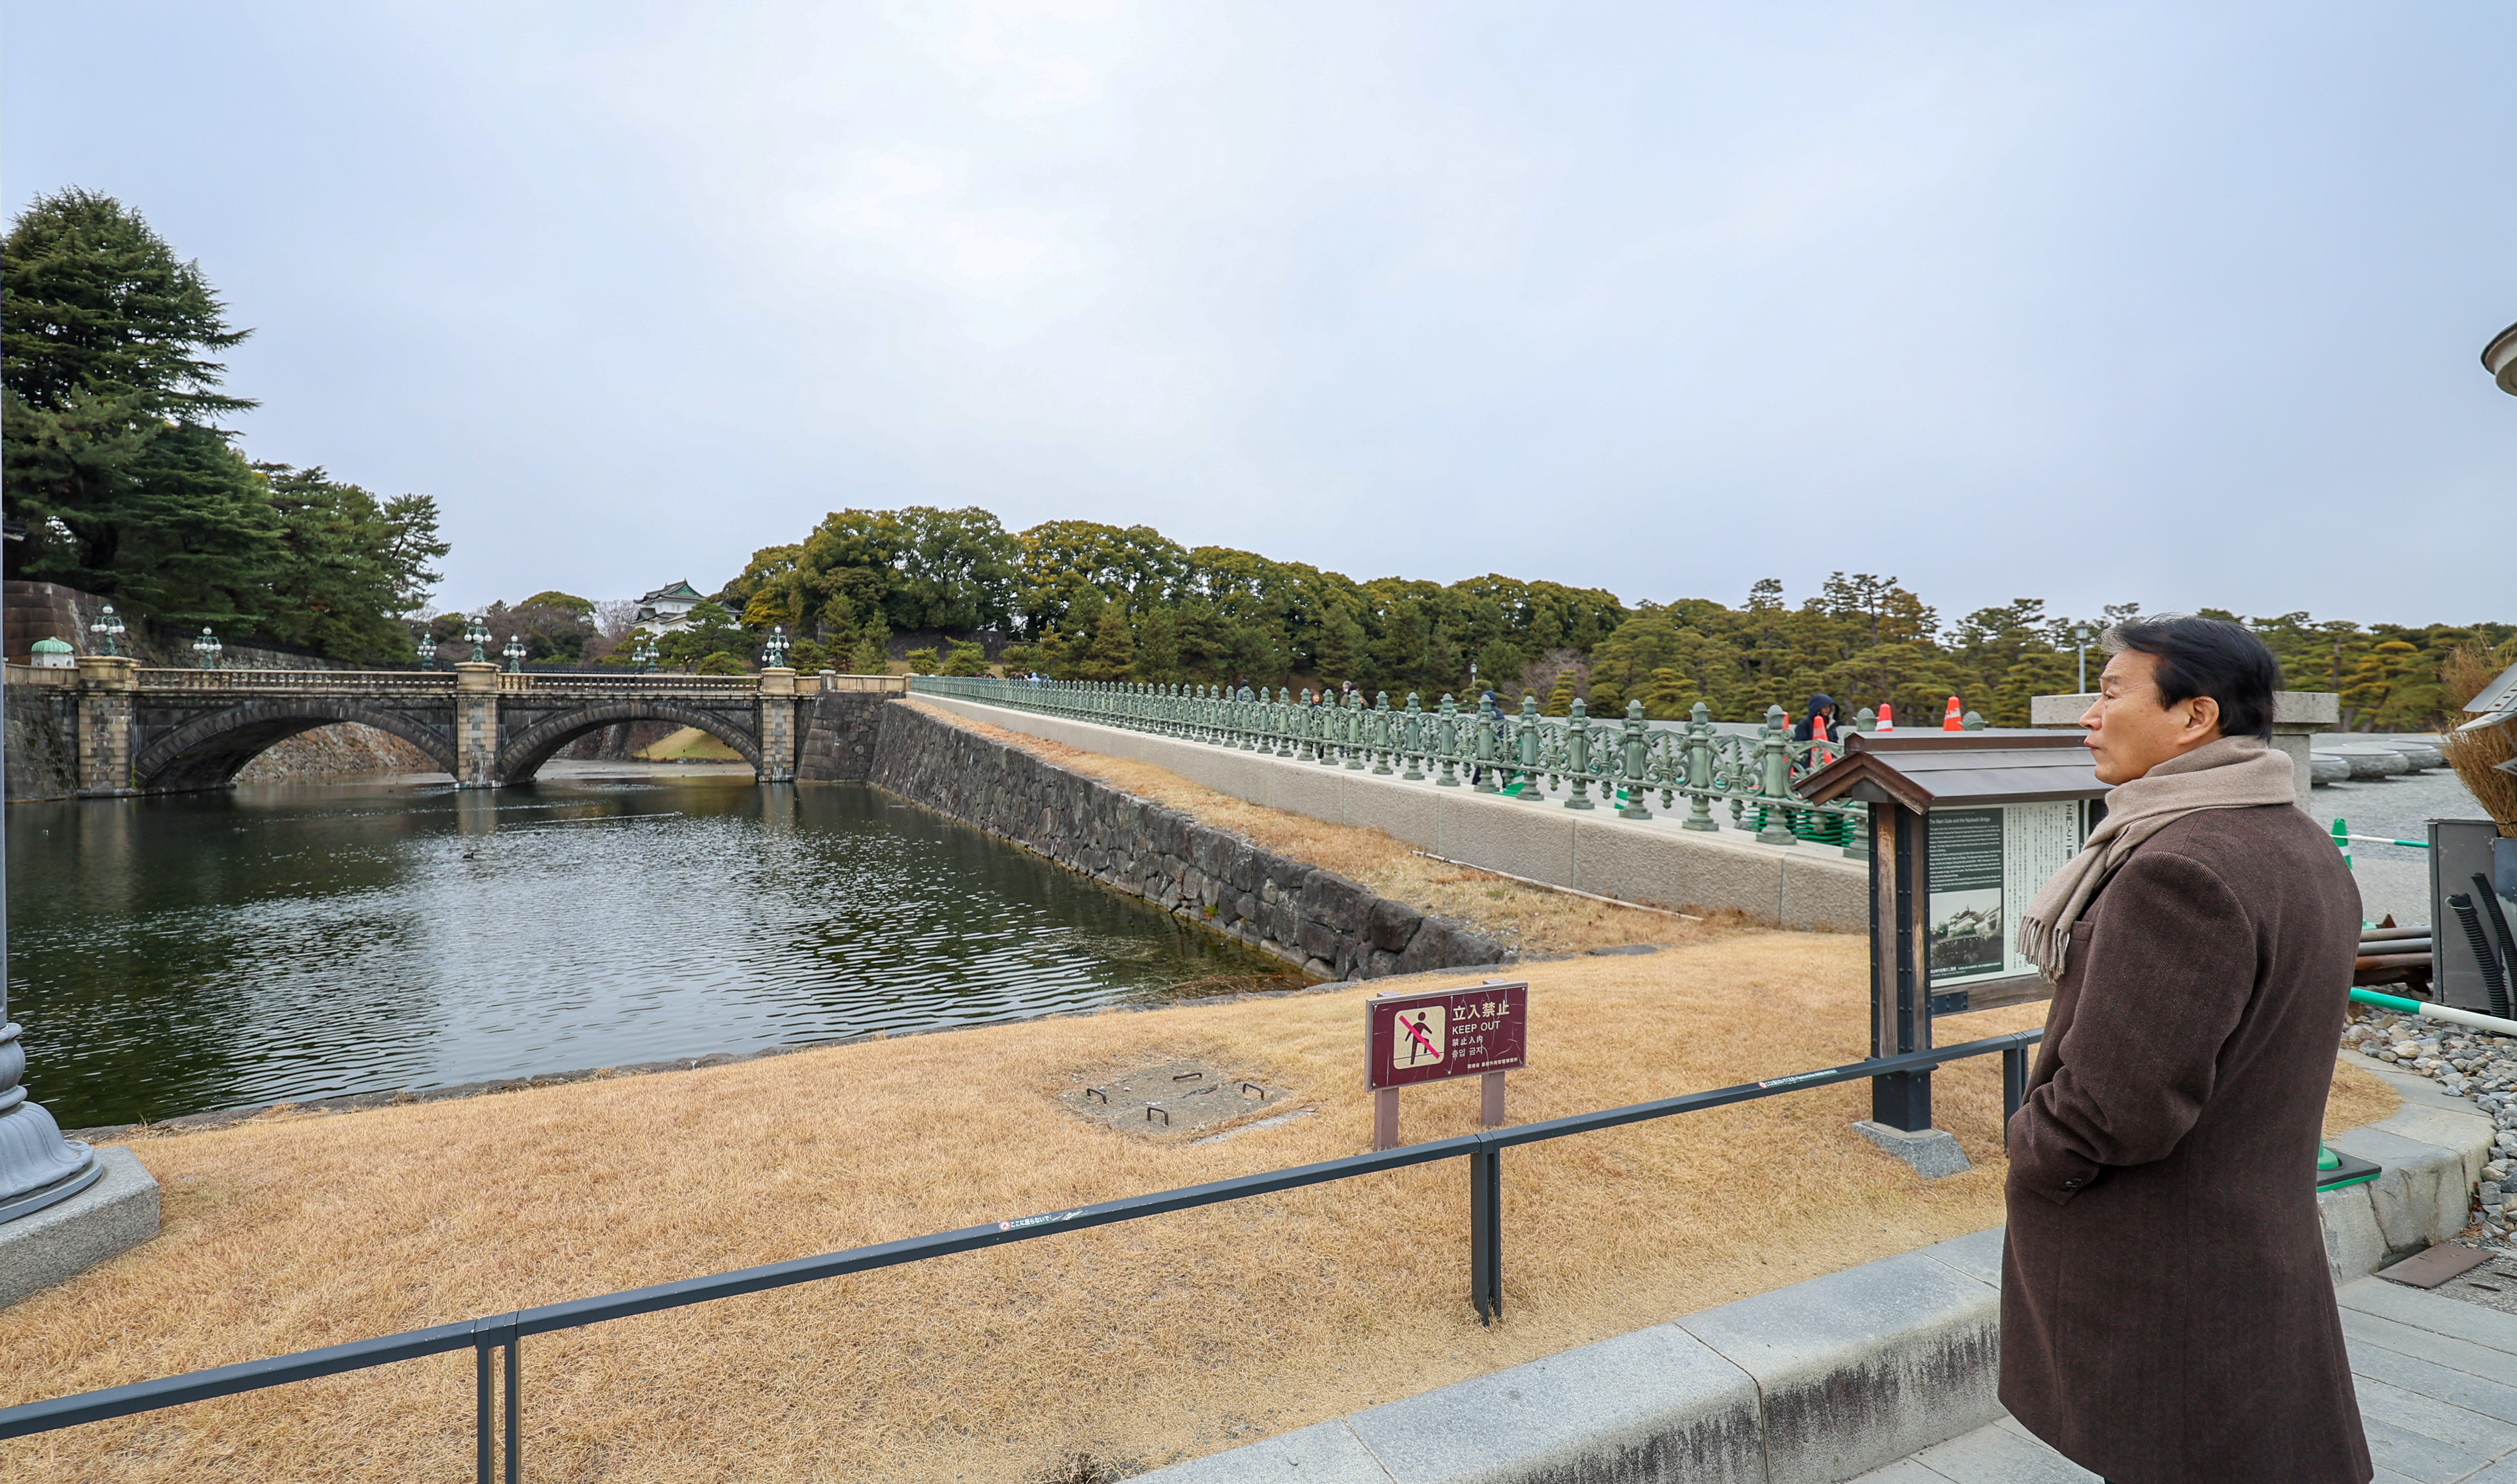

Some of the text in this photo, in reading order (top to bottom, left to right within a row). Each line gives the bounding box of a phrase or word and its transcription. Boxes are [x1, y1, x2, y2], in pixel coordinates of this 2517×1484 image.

[1452, 1000, 1510, 1021] 立入禁止
[1452, 1020, 1500, 1035] KEEP OUT
[1452, 1035, 1483, 1047] 禁止入内
[1469, 1047, 1482, 1056] 금지
